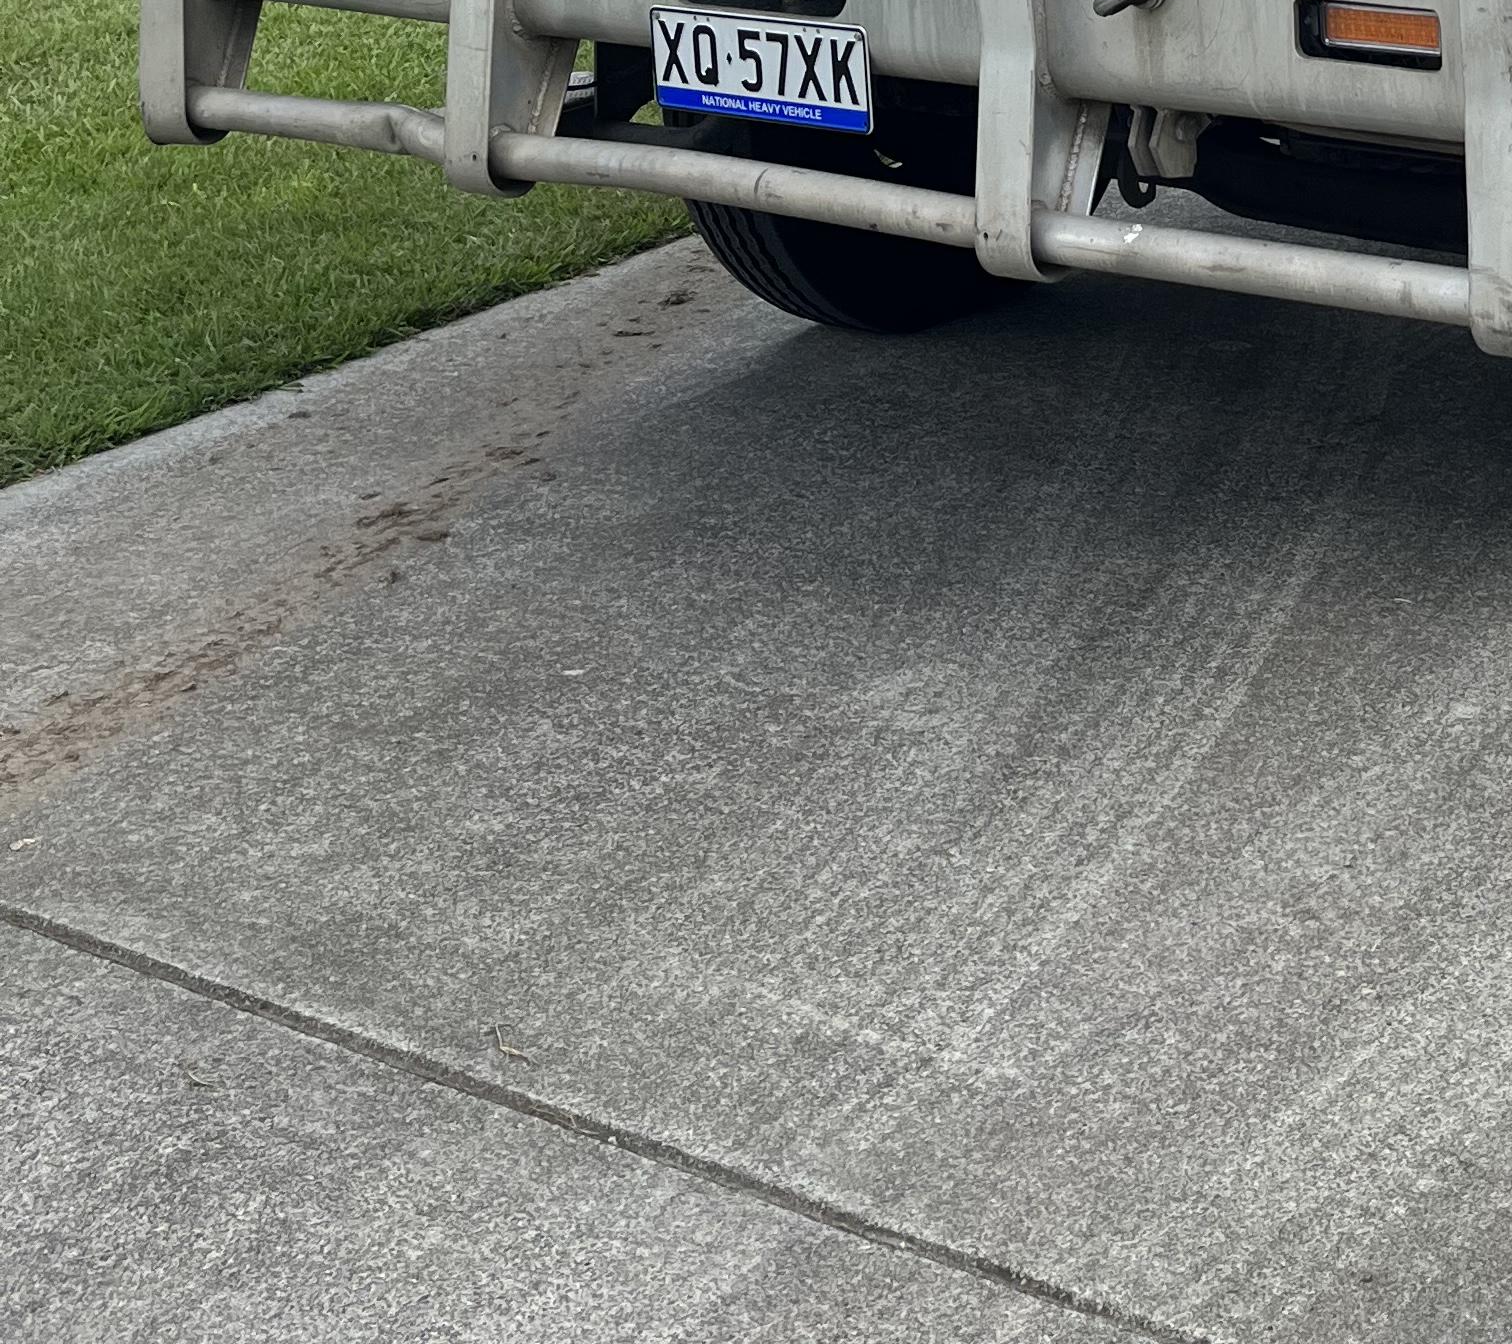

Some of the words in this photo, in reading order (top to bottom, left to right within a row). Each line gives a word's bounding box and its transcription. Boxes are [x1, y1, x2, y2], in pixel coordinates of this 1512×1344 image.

[701, 94, 747, 111] NATIONAL
[748, 100, 781, 115] HEAVY
[782, 105, 823, 121] VEHICLE
